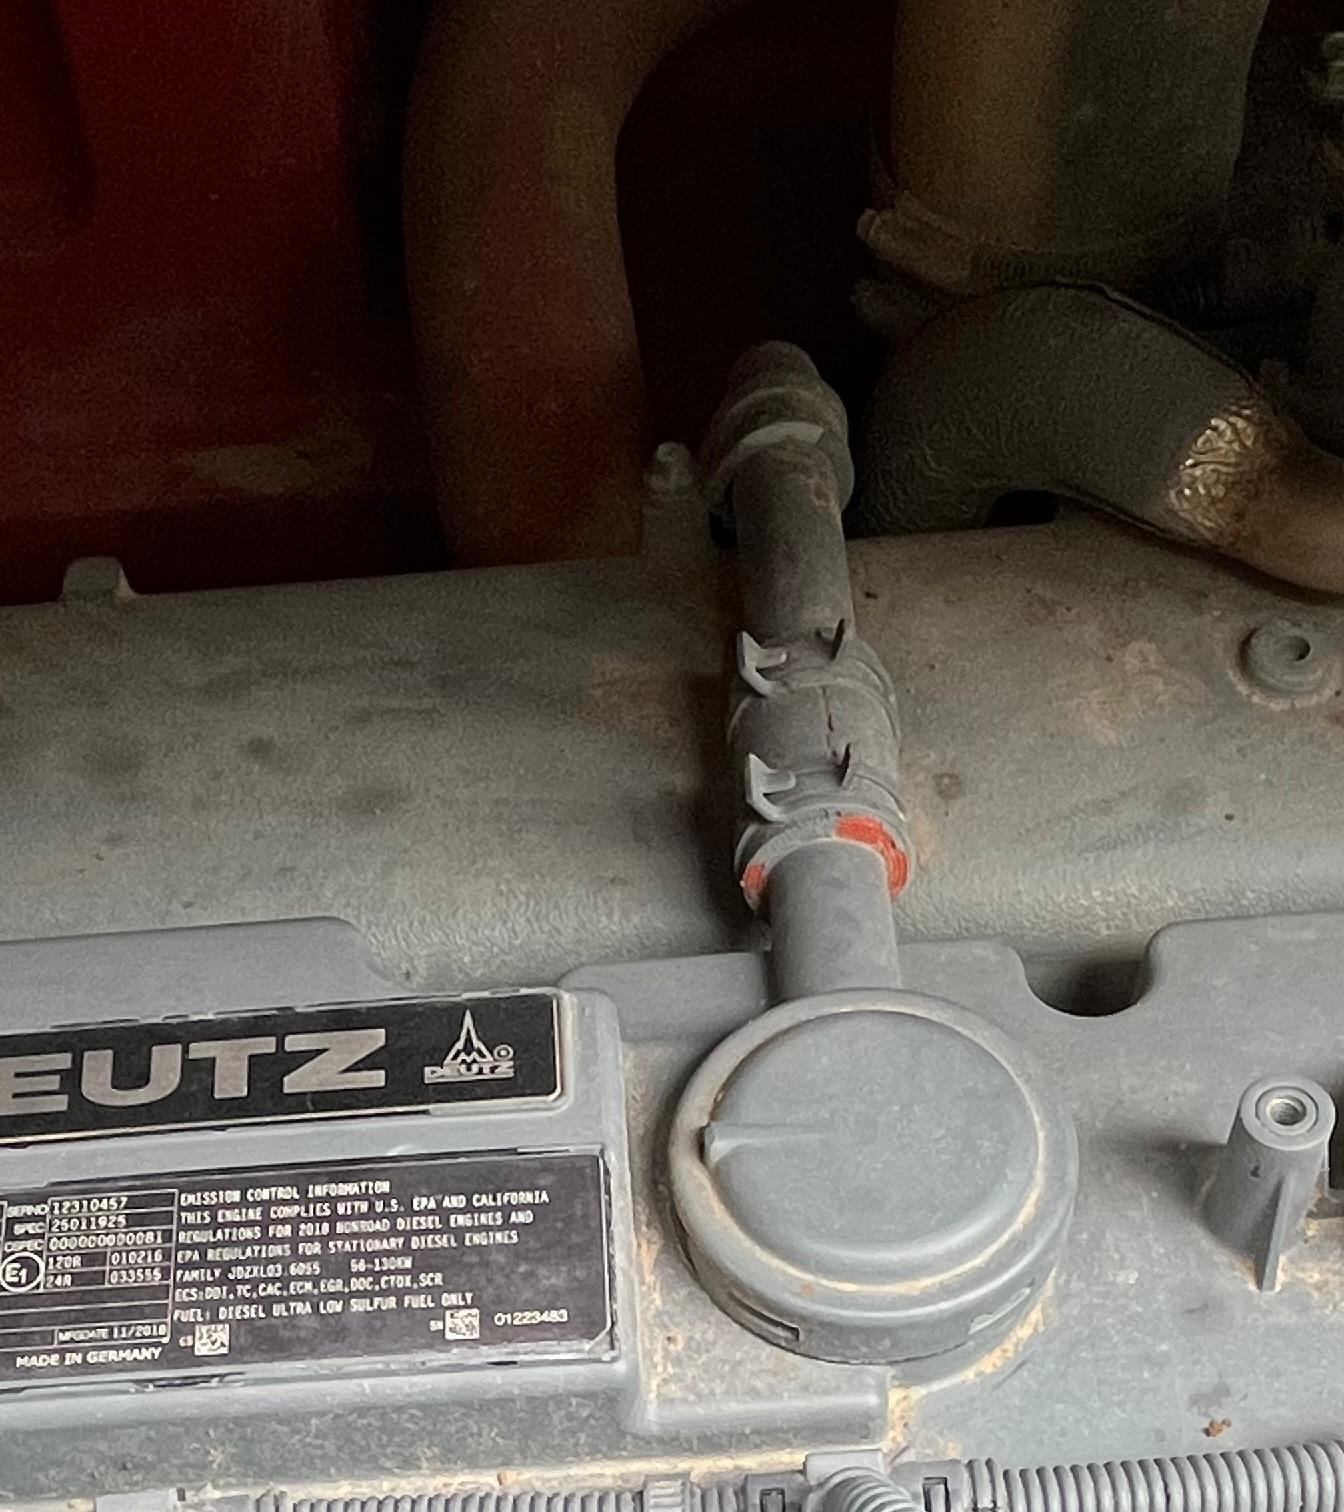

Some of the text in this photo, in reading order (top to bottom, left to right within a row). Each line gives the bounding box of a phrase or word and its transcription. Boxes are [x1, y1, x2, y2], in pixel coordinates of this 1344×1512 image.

[423, 1060, 514, 1083] DEUTZ
[52, 1196, 128, 1215] 12310457
[180, 1180, 391, 1207] EMISSION CONTROL INFORMATION
[180, 1210, 212, 1225] THIS
[217, 1206, 263, 1223] ENGINE
[270, 1202, 332, 1219] COMPLIES
[336, 1200, 369, 1216] WITH
[412, 1195, 437, 1211] EPA
[442, 1193, 466, 1208] AND
[472, 1190, 550, 1207] CALIFORNIA
[51, 1214, 127, 1232] 25011925
[178, 1226, 261, 1244] REGULATIONS
[268, 1224, 292, 1238] FOR
[335, 1218, 391, 1234] NONROAD
[396, 1215, 443, 1232] DIESEL
[449, 1212, 503, 1228] ENGINES
[509, 1209, 534, 1225] AND
[177, 1230, 519, 1264] EPA REGULATIONS FOR STATIONARY DIESEL ENGINES
[176, 1267, 222, 1283] FAMILY
[218, 1304, 266, 1320] DIESEL
[272, 1301, 312, 1317] ULTRA
[319, 1299, 344, 1314] LOW
[350, 1296, 397, 1312] SULFUR
[404, 1293, 436, 1309] FUEL
[441, 1291, 474, 1307] ONLY
[16, 1346, 162, 1369] MADE IN GERMANY
